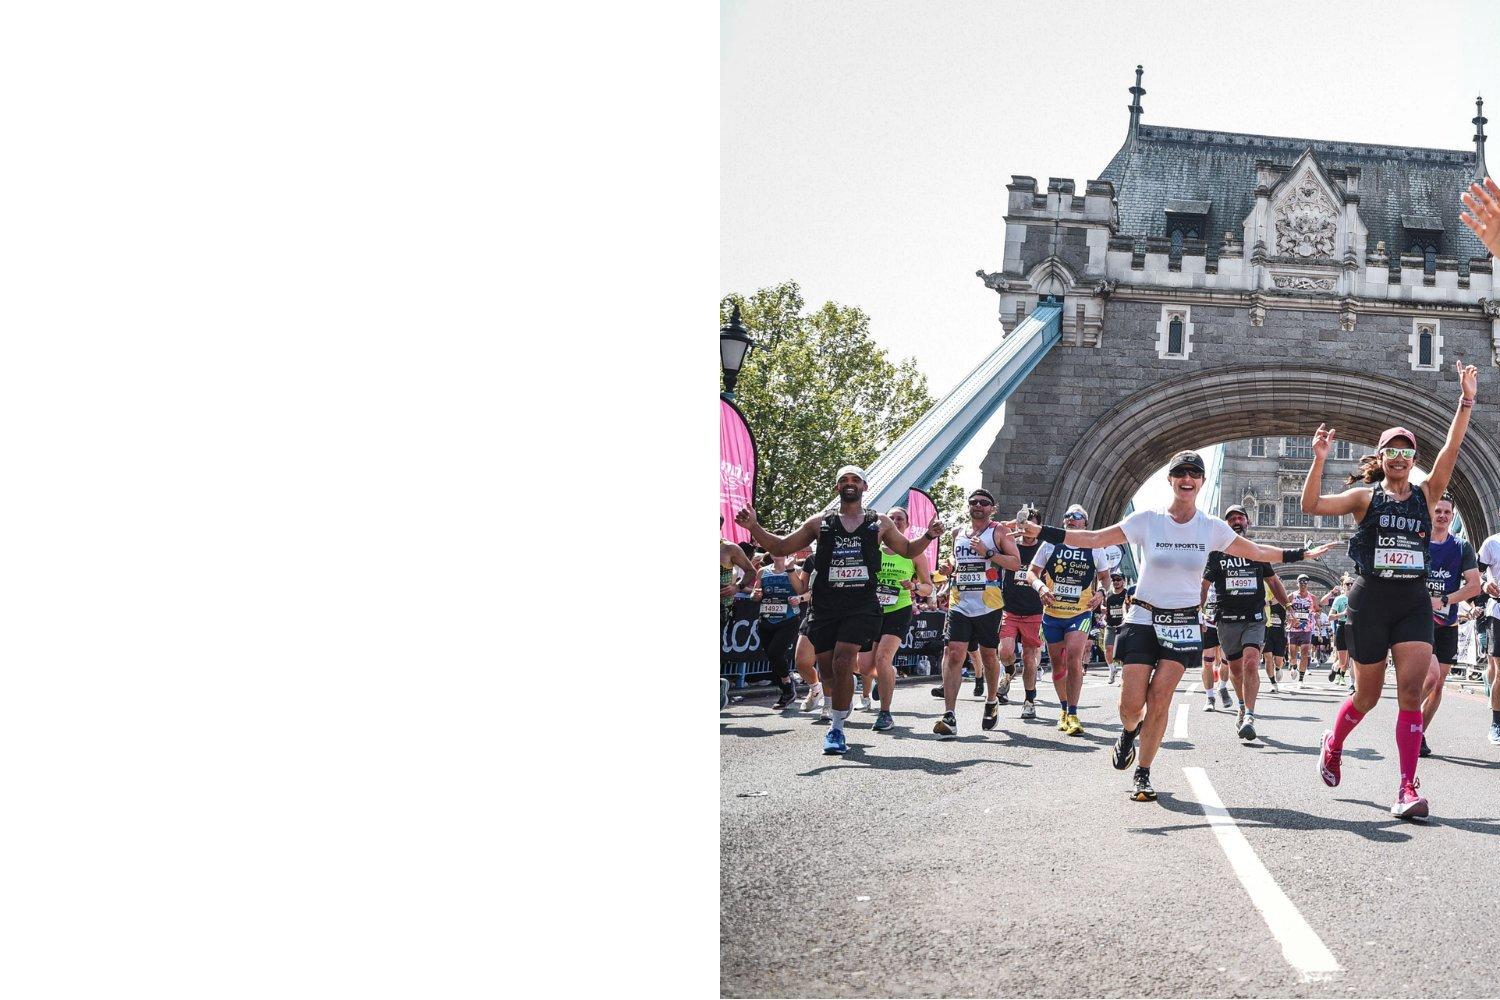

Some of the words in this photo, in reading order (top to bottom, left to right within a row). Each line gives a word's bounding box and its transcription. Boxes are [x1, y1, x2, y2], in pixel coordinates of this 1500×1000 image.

[1379, 514, 1422, 533] GIOVI
[1378, 535, 1396, 547] tcs
[1056, 548, 1088, 561] JOEL
[1383, 552, 1415, 565] 14271
[1069, 561, 1090, 570] Guide
[1219, 557, 1250, 570] PAUL
[836, 569, 863, 578] 14272
[1068, 567, 1086, 576] Dogs
[1227, 569, 1239, 577] tcs
[960, 573, 982, 582] 58033
[1231, 579, 1252, 587] 14997
[1056, 586, 1078, 594] 45611
[1161, 628, 1194, 640] 54412
